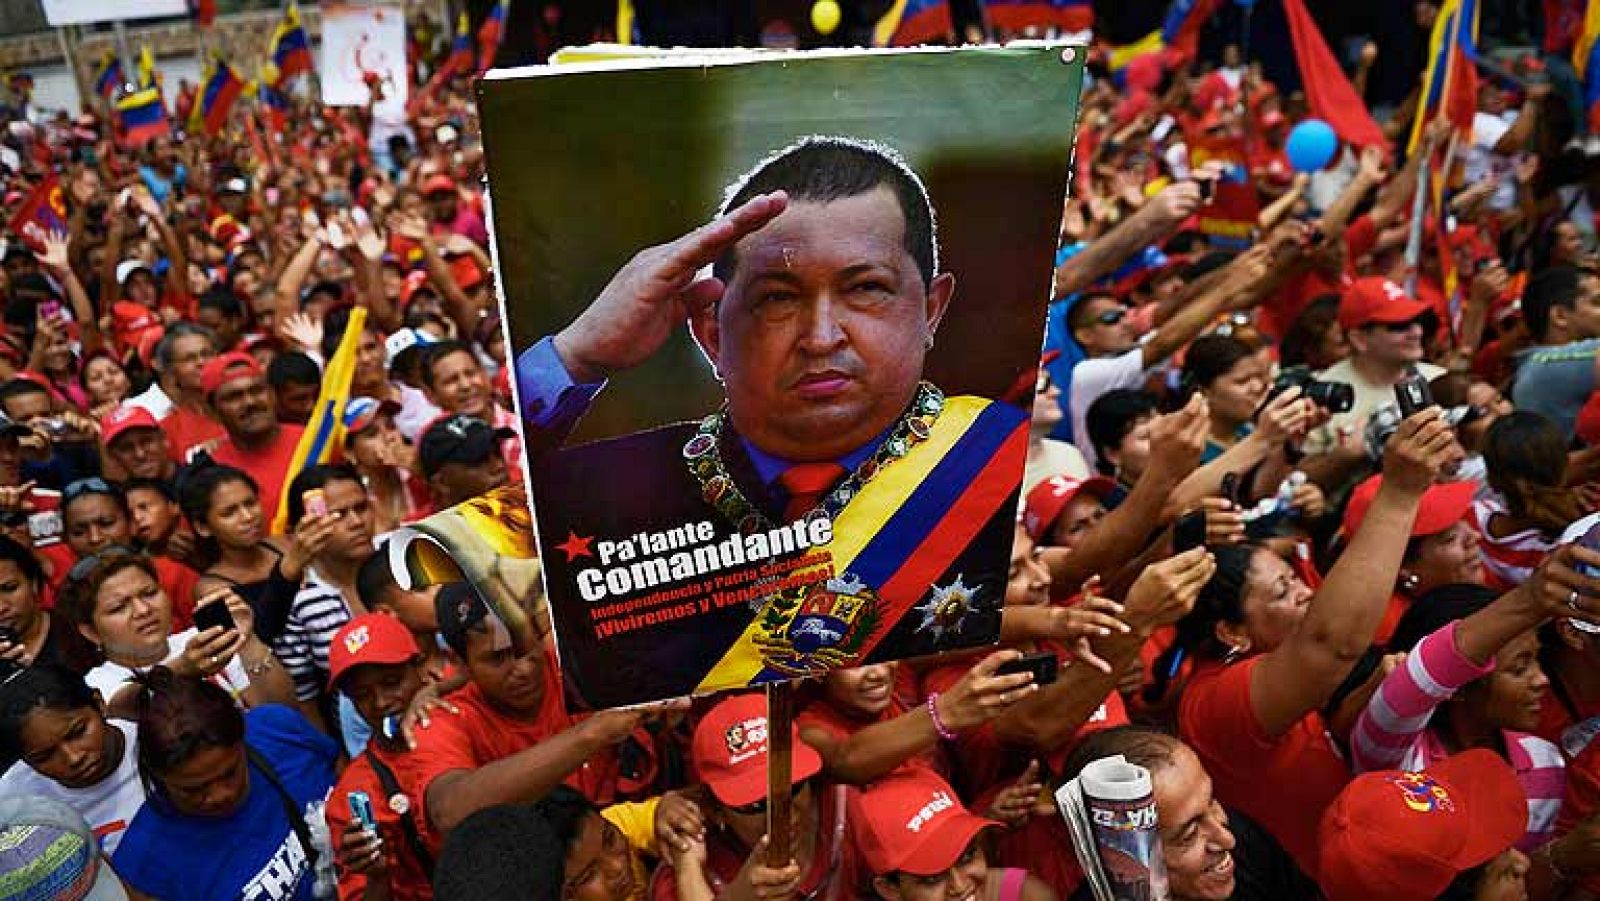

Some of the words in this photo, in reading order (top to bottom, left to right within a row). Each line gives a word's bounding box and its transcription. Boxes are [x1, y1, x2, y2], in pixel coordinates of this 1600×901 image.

[576, 517, 834, 602] Comandante
[597, 521, 716, 566] Pa'lante
[590, 581, 701, 620] Independencia
[703, 577, 713, 593] y
[714, 569, 758, 588] Patria
[700, 597, 710, 614] y
